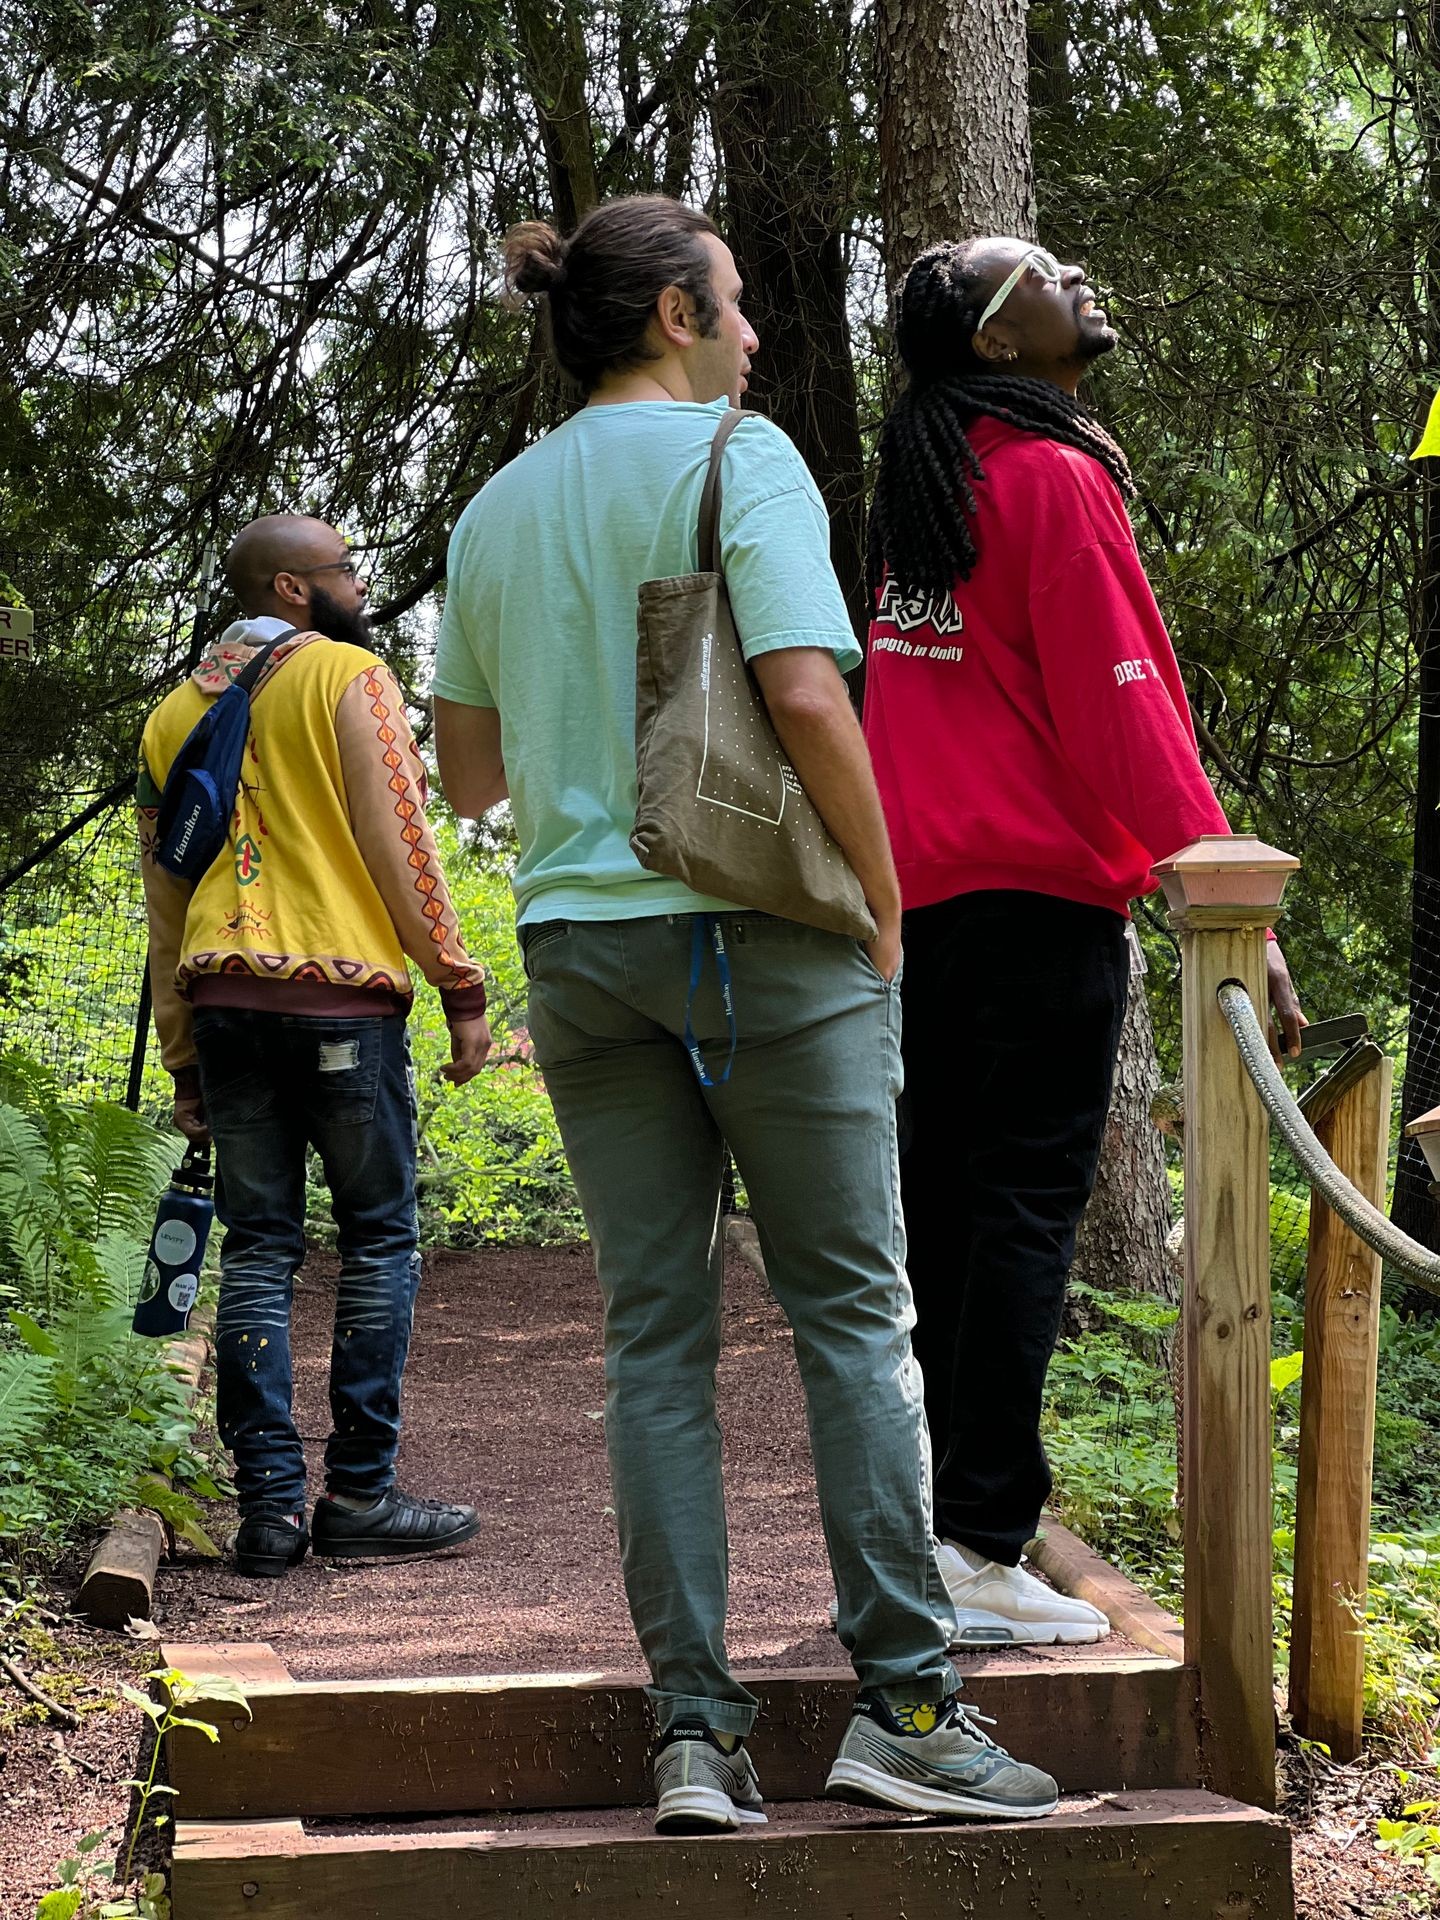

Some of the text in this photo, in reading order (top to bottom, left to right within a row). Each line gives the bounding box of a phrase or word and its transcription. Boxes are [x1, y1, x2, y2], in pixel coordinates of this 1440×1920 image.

[913, 644, 928, 657] in
[928, 645, 964, 662] Unity
[1113, 659, 1147, 687] DRE
[173, 804, 202, 864] Hamilton
[714, 922, 725, 954] Hamilton
[723, 983, 732, 1016] Hamilton
[690, 1047, 706, 1079] Hamilton
[160, 1231, 185, 1245] LEVITT
[673, 1729, 704, 1738] saucony
